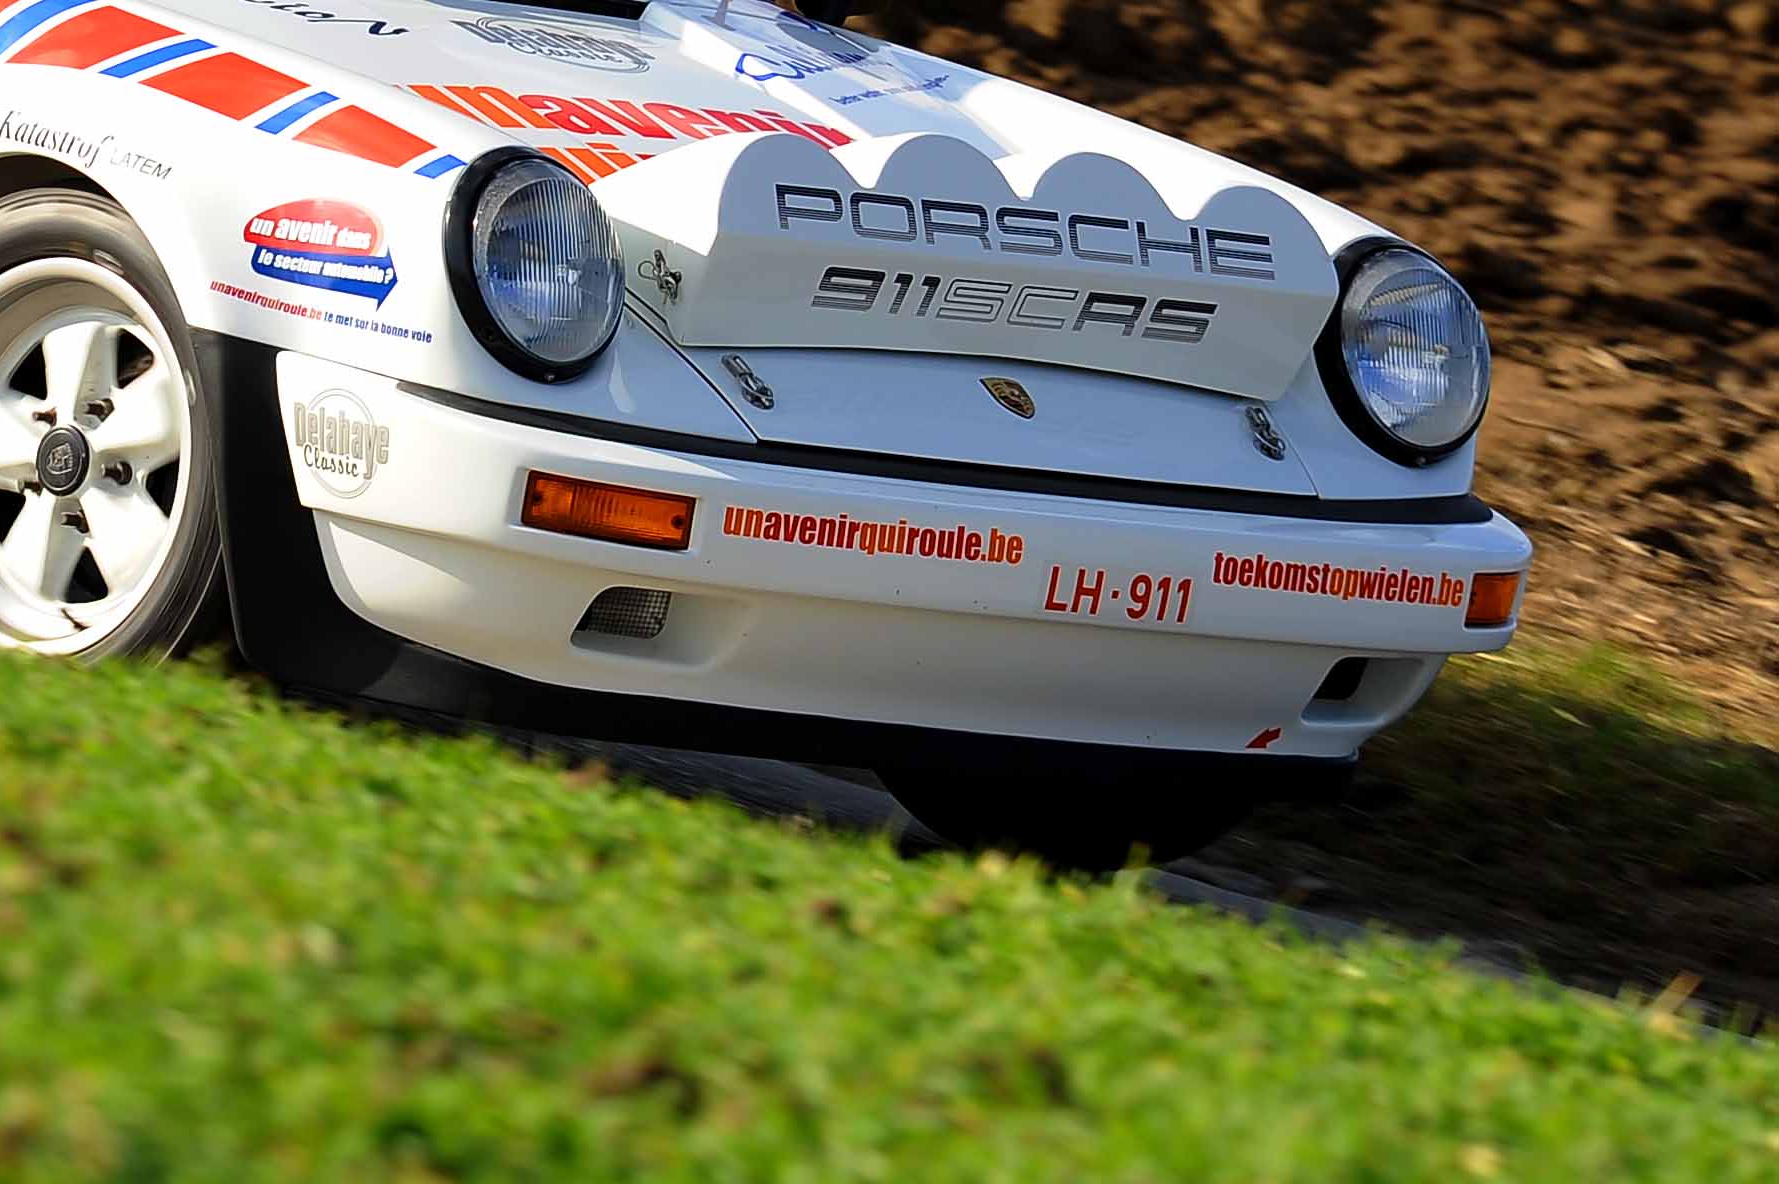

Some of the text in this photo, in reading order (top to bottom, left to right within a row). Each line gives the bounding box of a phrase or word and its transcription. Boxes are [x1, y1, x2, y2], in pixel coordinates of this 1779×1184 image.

[249, 217, 275, 236] un
[274, 218, 339, 246] avenir
[774, 183, 1276, 281] PORSCHE
[209, 279, 322, 321] unavenirquiroule.be
[335, 314, 354, 328] met
[380, 324, 410, 339] bonne
[411, 328, 433, 344] voie
[293, 401, 391, 481] Delahaye
[303, 443, 360, 478] Classic
[723, 504, 1023, 564] unavenirquiroule.be
[1213, 551, 1465, 607] toekomstopwielen.be
